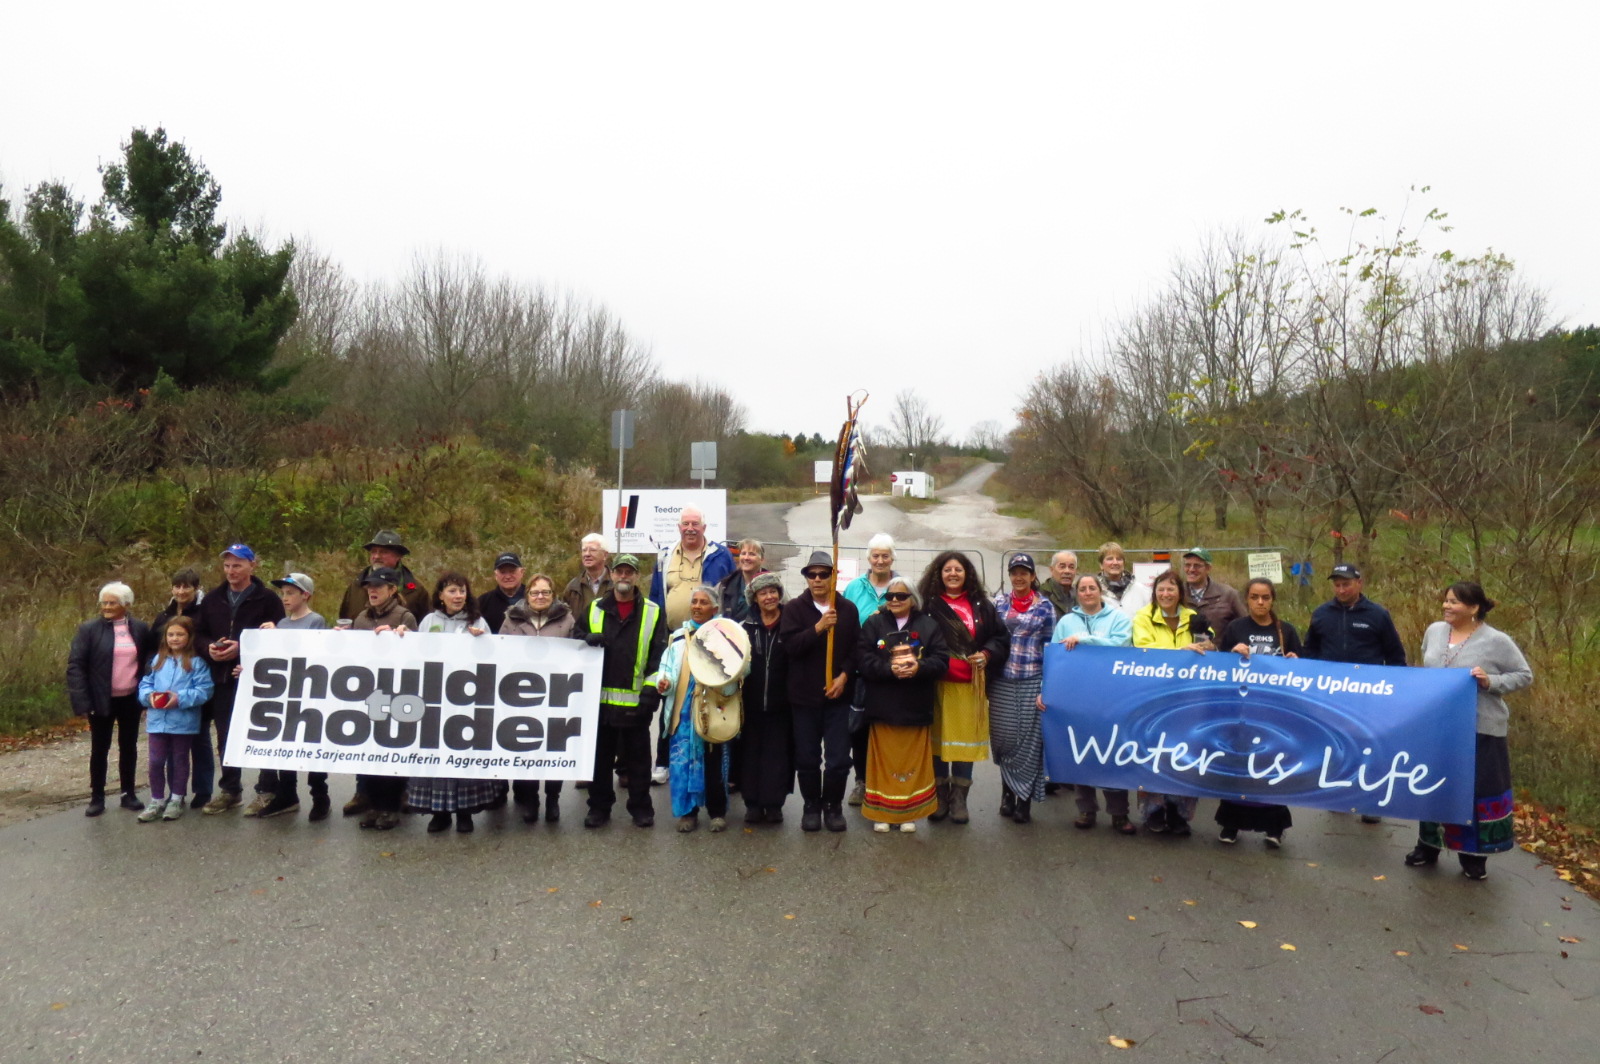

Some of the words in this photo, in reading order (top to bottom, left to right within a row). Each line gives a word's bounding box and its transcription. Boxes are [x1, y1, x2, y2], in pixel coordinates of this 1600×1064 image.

[252, 657, 584, 708] Shoulder
[1112, 660, 1174, 679] Friends
[1177, 664, 1198, 680] of
[1199, 665, 1228, 682] the
[1231, 667, 1314, 692] Waverley
[1316, 674, 1394, 695] Uplands
[246, 700, 582, 752] Shoulder
[365, 689, 426, 723] to
[244, 745, 273, 757] Please
[273, 747, 294, 760] stop
[295, 747, 313, 759] the
[314, 748, 366, 763] Sarjeant
[367, 752, 389, 763] and
[391, 752, 441, 765] Dufferin
[445, 754, 510, 769] Aggregate
[512, 756, 577, 770] Expansion
[1067, 723, 1225, 776] Water
[1247, 736, 1303, 786] is
[1318, 745, 1447, 807] Life
